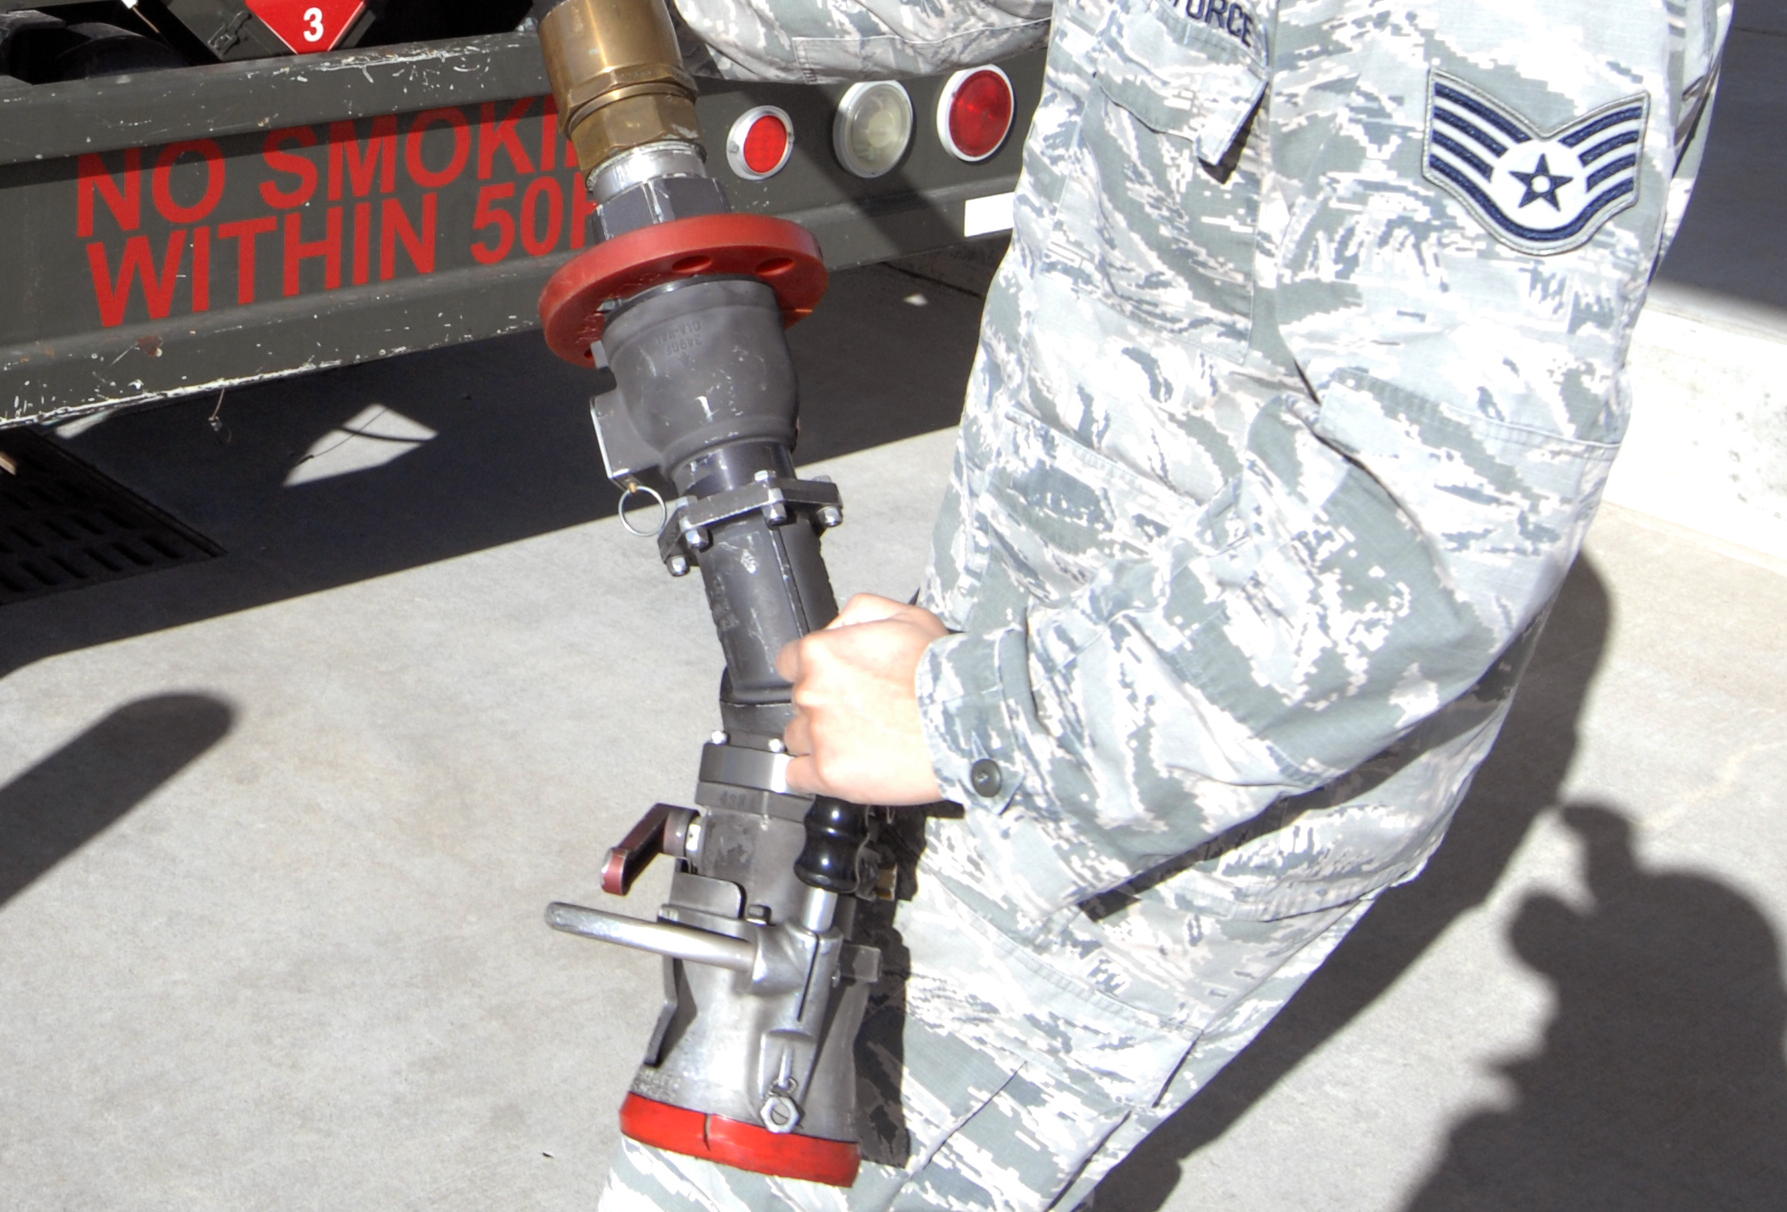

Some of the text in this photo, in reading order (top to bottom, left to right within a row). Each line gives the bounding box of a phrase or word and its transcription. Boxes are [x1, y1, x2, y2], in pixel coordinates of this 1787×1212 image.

[303, 7, 324, 43] 3
[76, 94, 580, 238] NO SMOKI
[86, 173, 599, 328] WITHIN 50F
